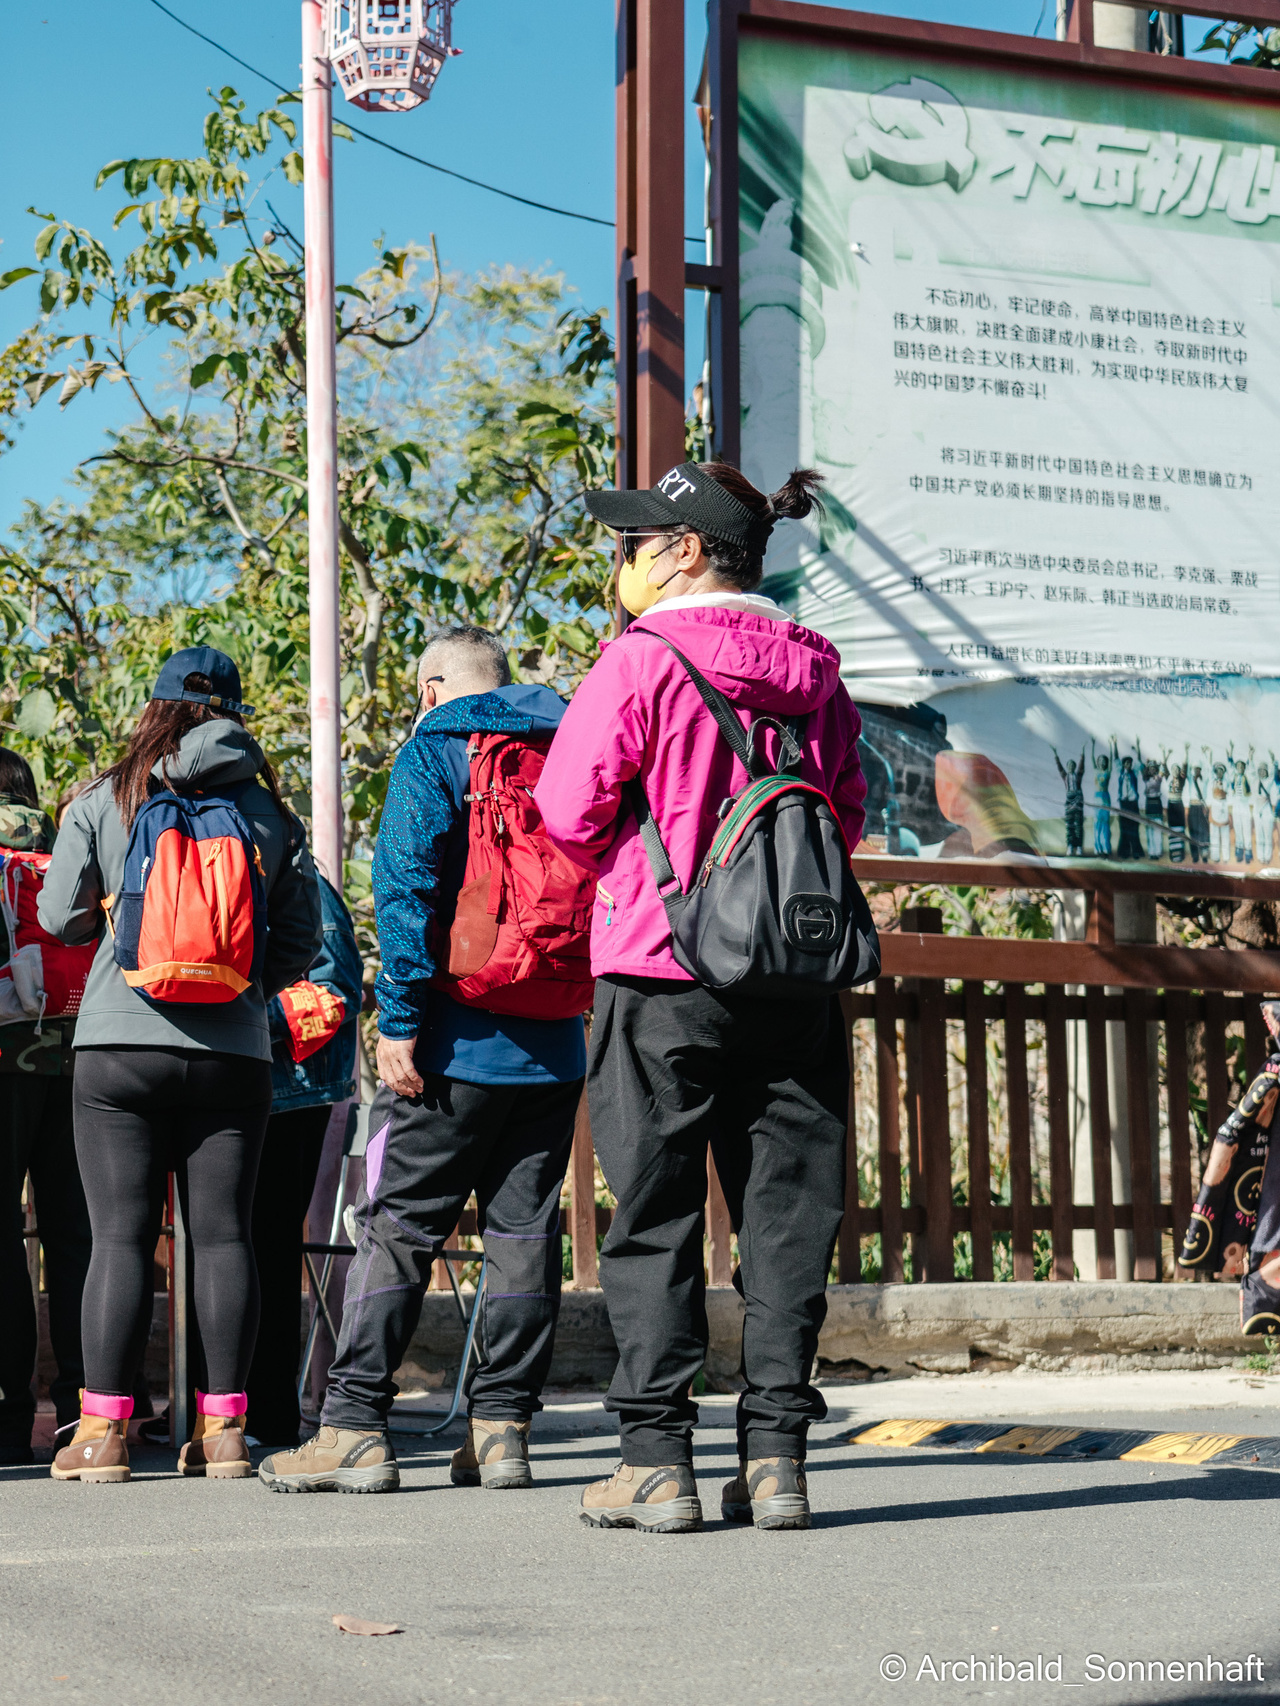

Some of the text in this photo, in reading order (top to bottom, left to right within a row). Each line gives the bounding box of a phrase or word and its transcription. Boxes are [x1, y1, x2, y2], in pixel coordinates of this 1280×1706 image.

[988, 122, 1280, 226] 不忘初心
[925, 286, 1246, 338] 不忘初心，牢记使命，高举中国特色社会主义
[893, 311, 1248, 365] 伟大旗帜，决胜全面建成小康社会，夺取新时代中
[893, 340, 1249, 394] 国特色社会主义伟大胜利，为实现中华民族伟大复
[940, 446, 1252, 491] 将习近平新时代中国特色社会主义思想确立为
[909, 475, 1170, 512] 中国共产党必须长期坚持的指导思想。
[180, 968, 212, 976] QUECHUA
[285, 987, 326, 1041] 督员
[350, 1440, 373, 1459] SCARPA
[641, 1472, 666, 1495] SCARPA
